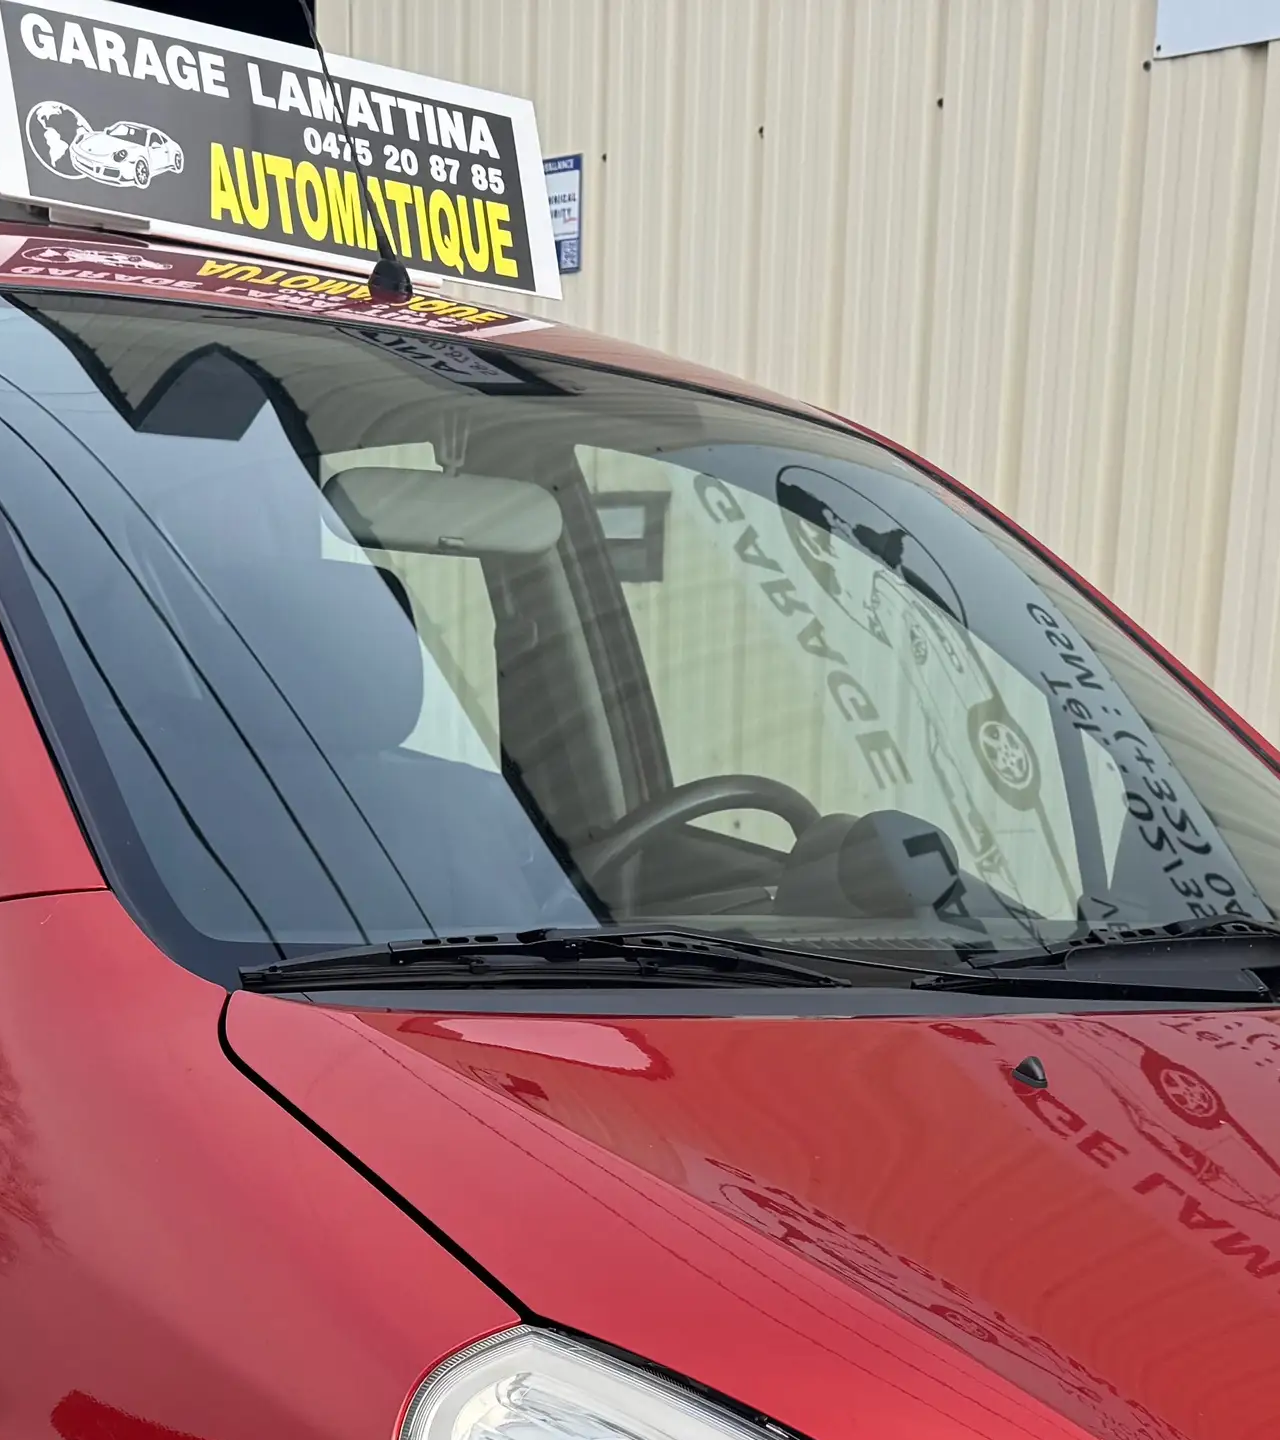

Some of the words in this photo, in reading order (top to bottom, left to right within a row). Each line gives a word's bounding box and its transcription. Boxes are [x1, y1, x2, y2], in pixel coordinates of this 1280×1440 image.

[21, 12, 230, 98] GARAGE
[248, 62, 500, 160] LAMATTINA
[211, 142, 518, 278] AUTOMATIQUE
[303, 127, 373, 167] 0475
[383, 145, 418, 176] 20
[429, 154, 460, 185] 87
[471, 163, 505, 195] 85
